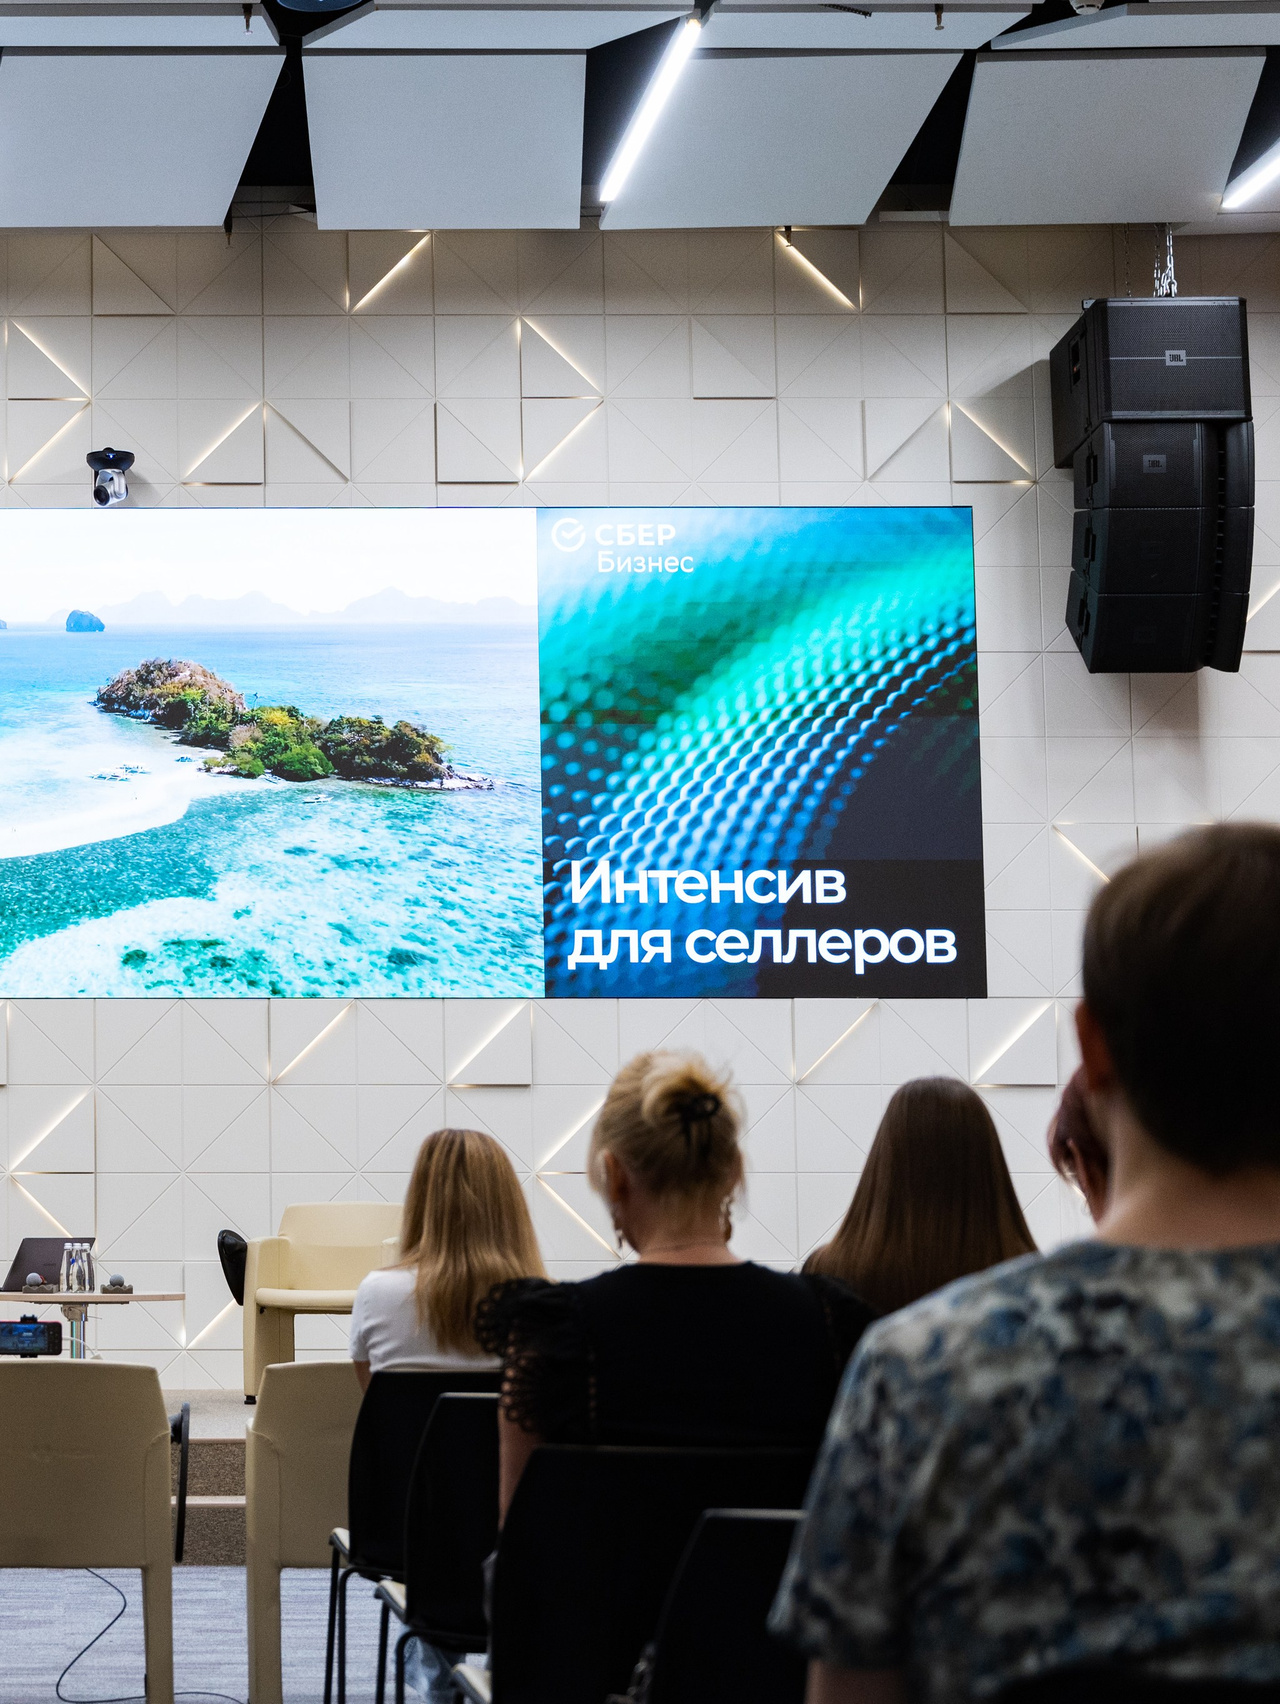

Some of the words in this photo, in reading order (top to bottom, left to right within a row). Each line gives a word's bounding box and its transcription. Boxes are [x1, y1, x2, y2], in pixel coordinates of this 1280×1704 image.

[595, 524, 676, 546] СБЕР
[598, 551, 694, 573] Бизнес
[571, 860, 847, 904] Интенсив
[567, 929, 672, 970] для
[685, 928, 958, 975] селлеров
